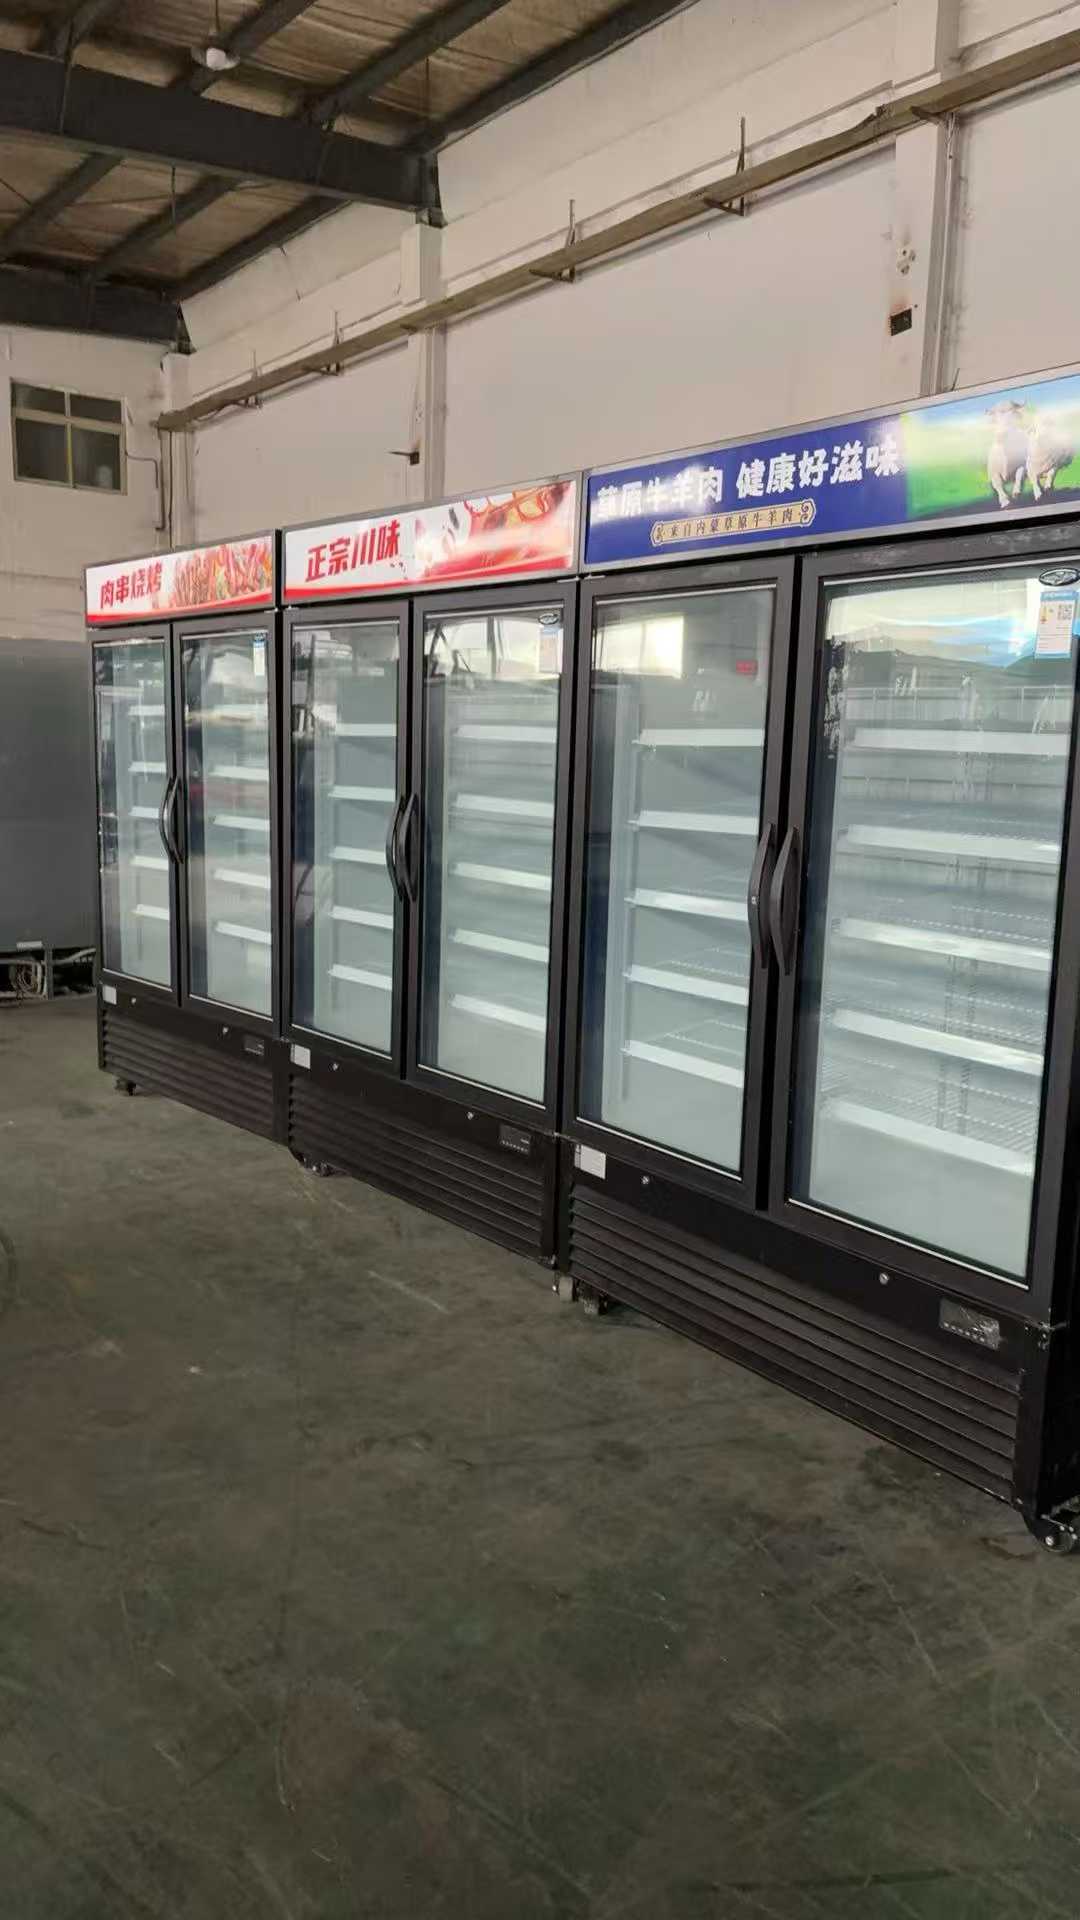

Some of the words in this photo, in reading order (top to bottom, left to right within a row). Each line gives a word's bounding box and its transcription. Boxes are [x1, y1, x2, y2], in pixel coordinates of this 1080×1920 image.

[736, 438, 900, 499] 健康好滋味
[305, 520, 400, 582] 正宗川味
[100, 562, 162, 609] 肉串烧烤
